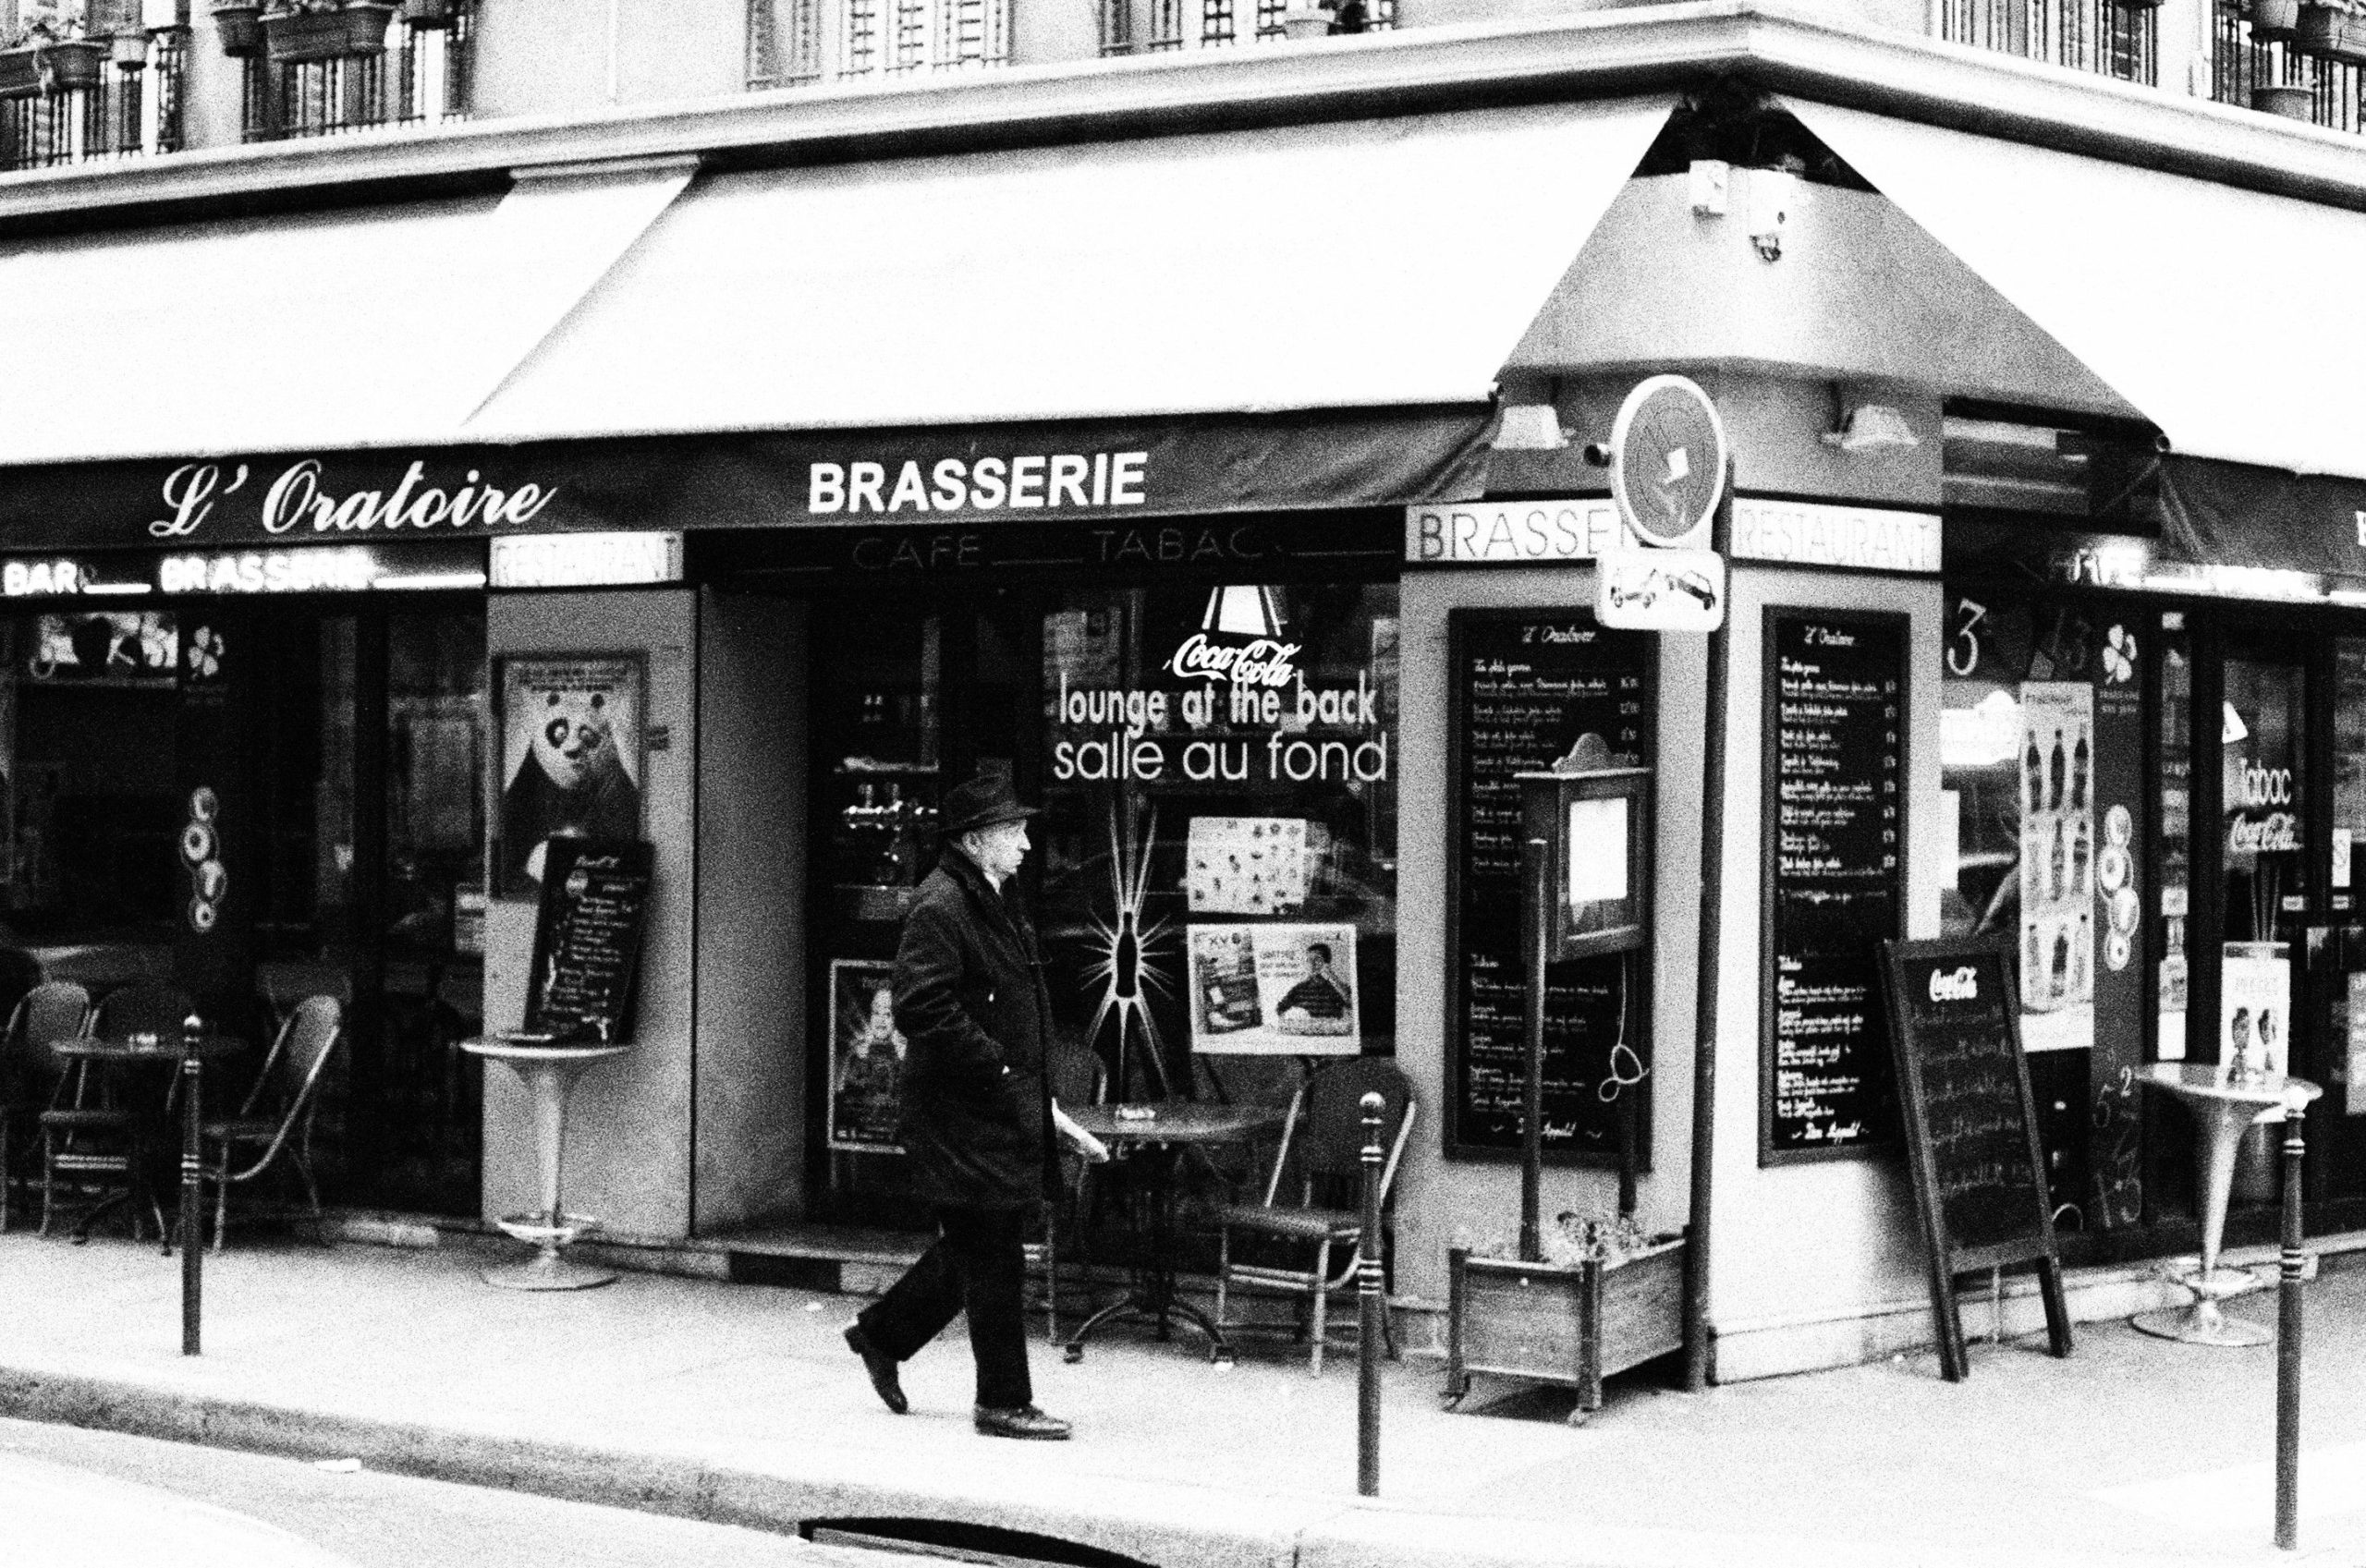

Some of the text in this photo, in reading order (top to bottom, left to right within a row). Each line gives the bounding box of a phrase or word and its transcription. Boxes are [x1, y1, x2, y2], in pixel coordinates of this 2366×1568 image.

[148, 460, 558, 538] L' Oratoire
[809, 450, 1149, 514] BRASSERIE
[1092, 527, 1262, 563] TABAC
[1418, 507, 1628, 558] BRASSE
[1738, 506, 1930, 569] RESTAURANT
[3, 545, 374, 596] BAR BRASSERIE
[1059, 668, 1378, 739] lounge at the back
[1053, 730, 1388, 782] salle au fond
